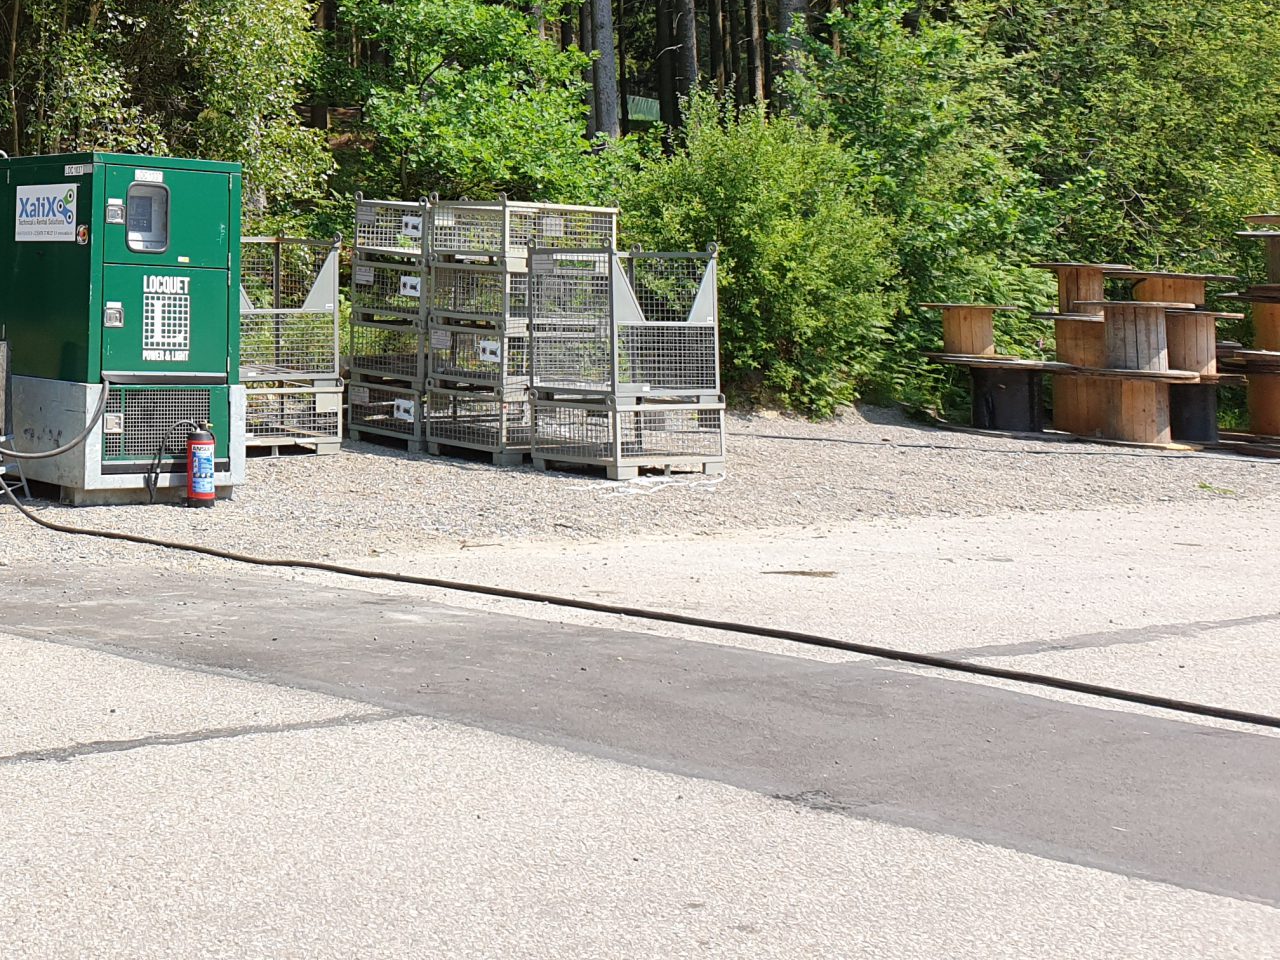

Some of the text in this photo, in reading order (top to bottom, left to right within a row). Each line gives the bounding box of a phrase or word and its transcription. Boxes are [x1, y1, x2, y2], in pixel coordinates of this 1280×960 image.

[19, 196, 58, 218] XaliX
[143, 275, 190, 294] LOCQUET
[142, 349, 189, 361] POWER & LIGHT
